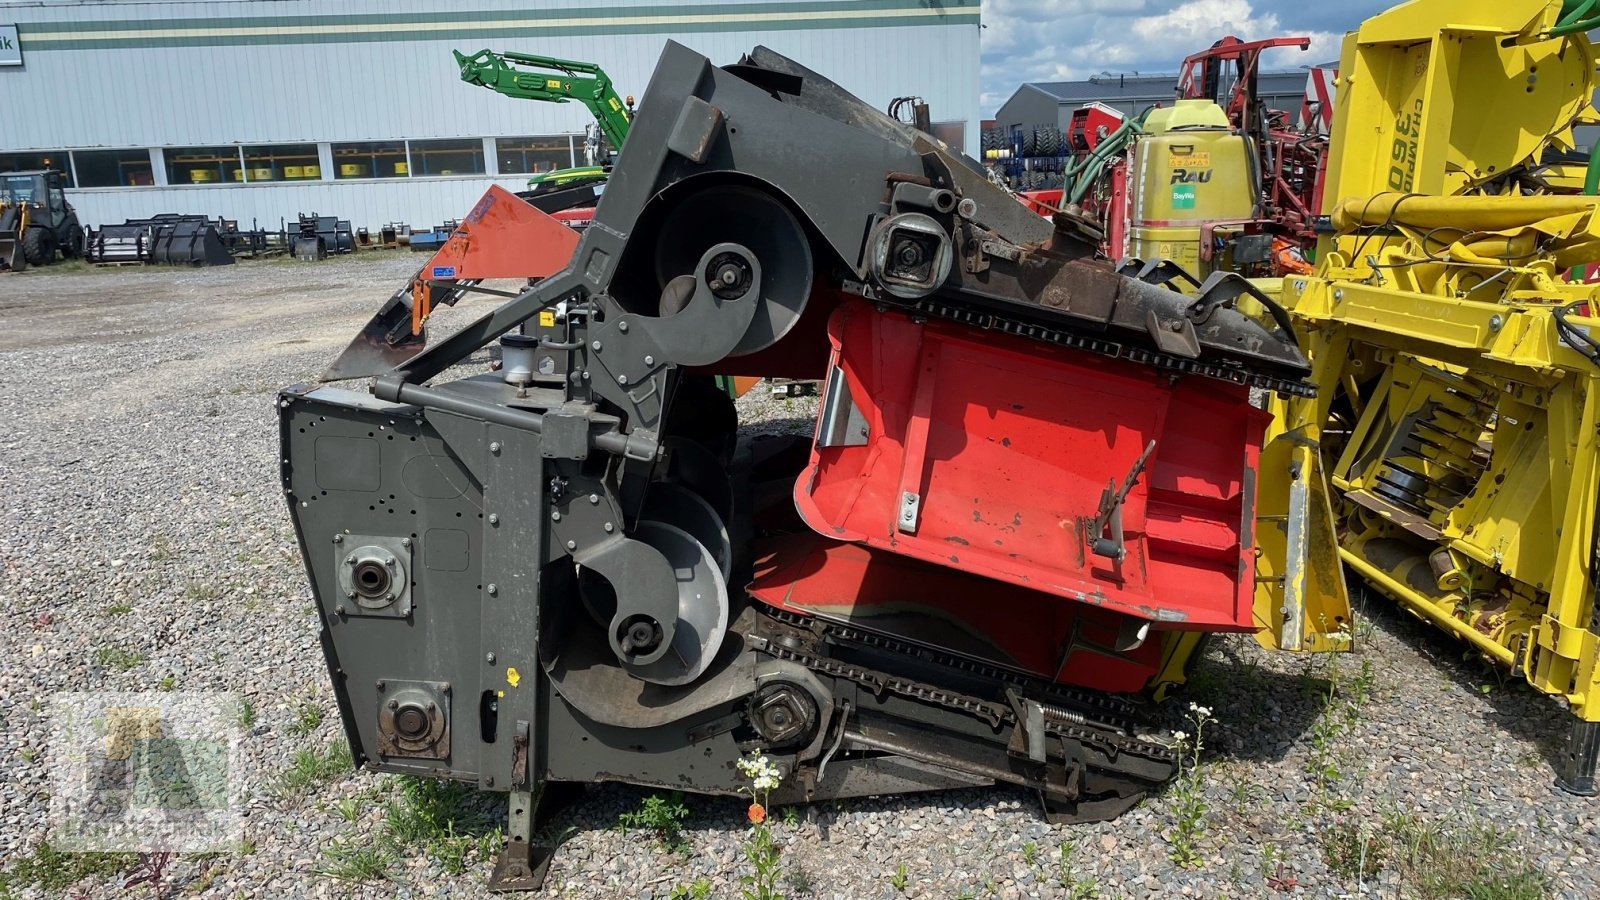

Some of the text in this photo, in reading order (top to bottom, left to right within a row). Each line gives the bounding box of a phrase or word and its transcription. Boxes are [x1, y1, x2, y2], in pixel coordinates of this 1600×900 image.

[1388, 109, 1411, 191] 360
[1170, 168, 1213, 185] RAU
[1173, 192, 1195, 200] BayWa
